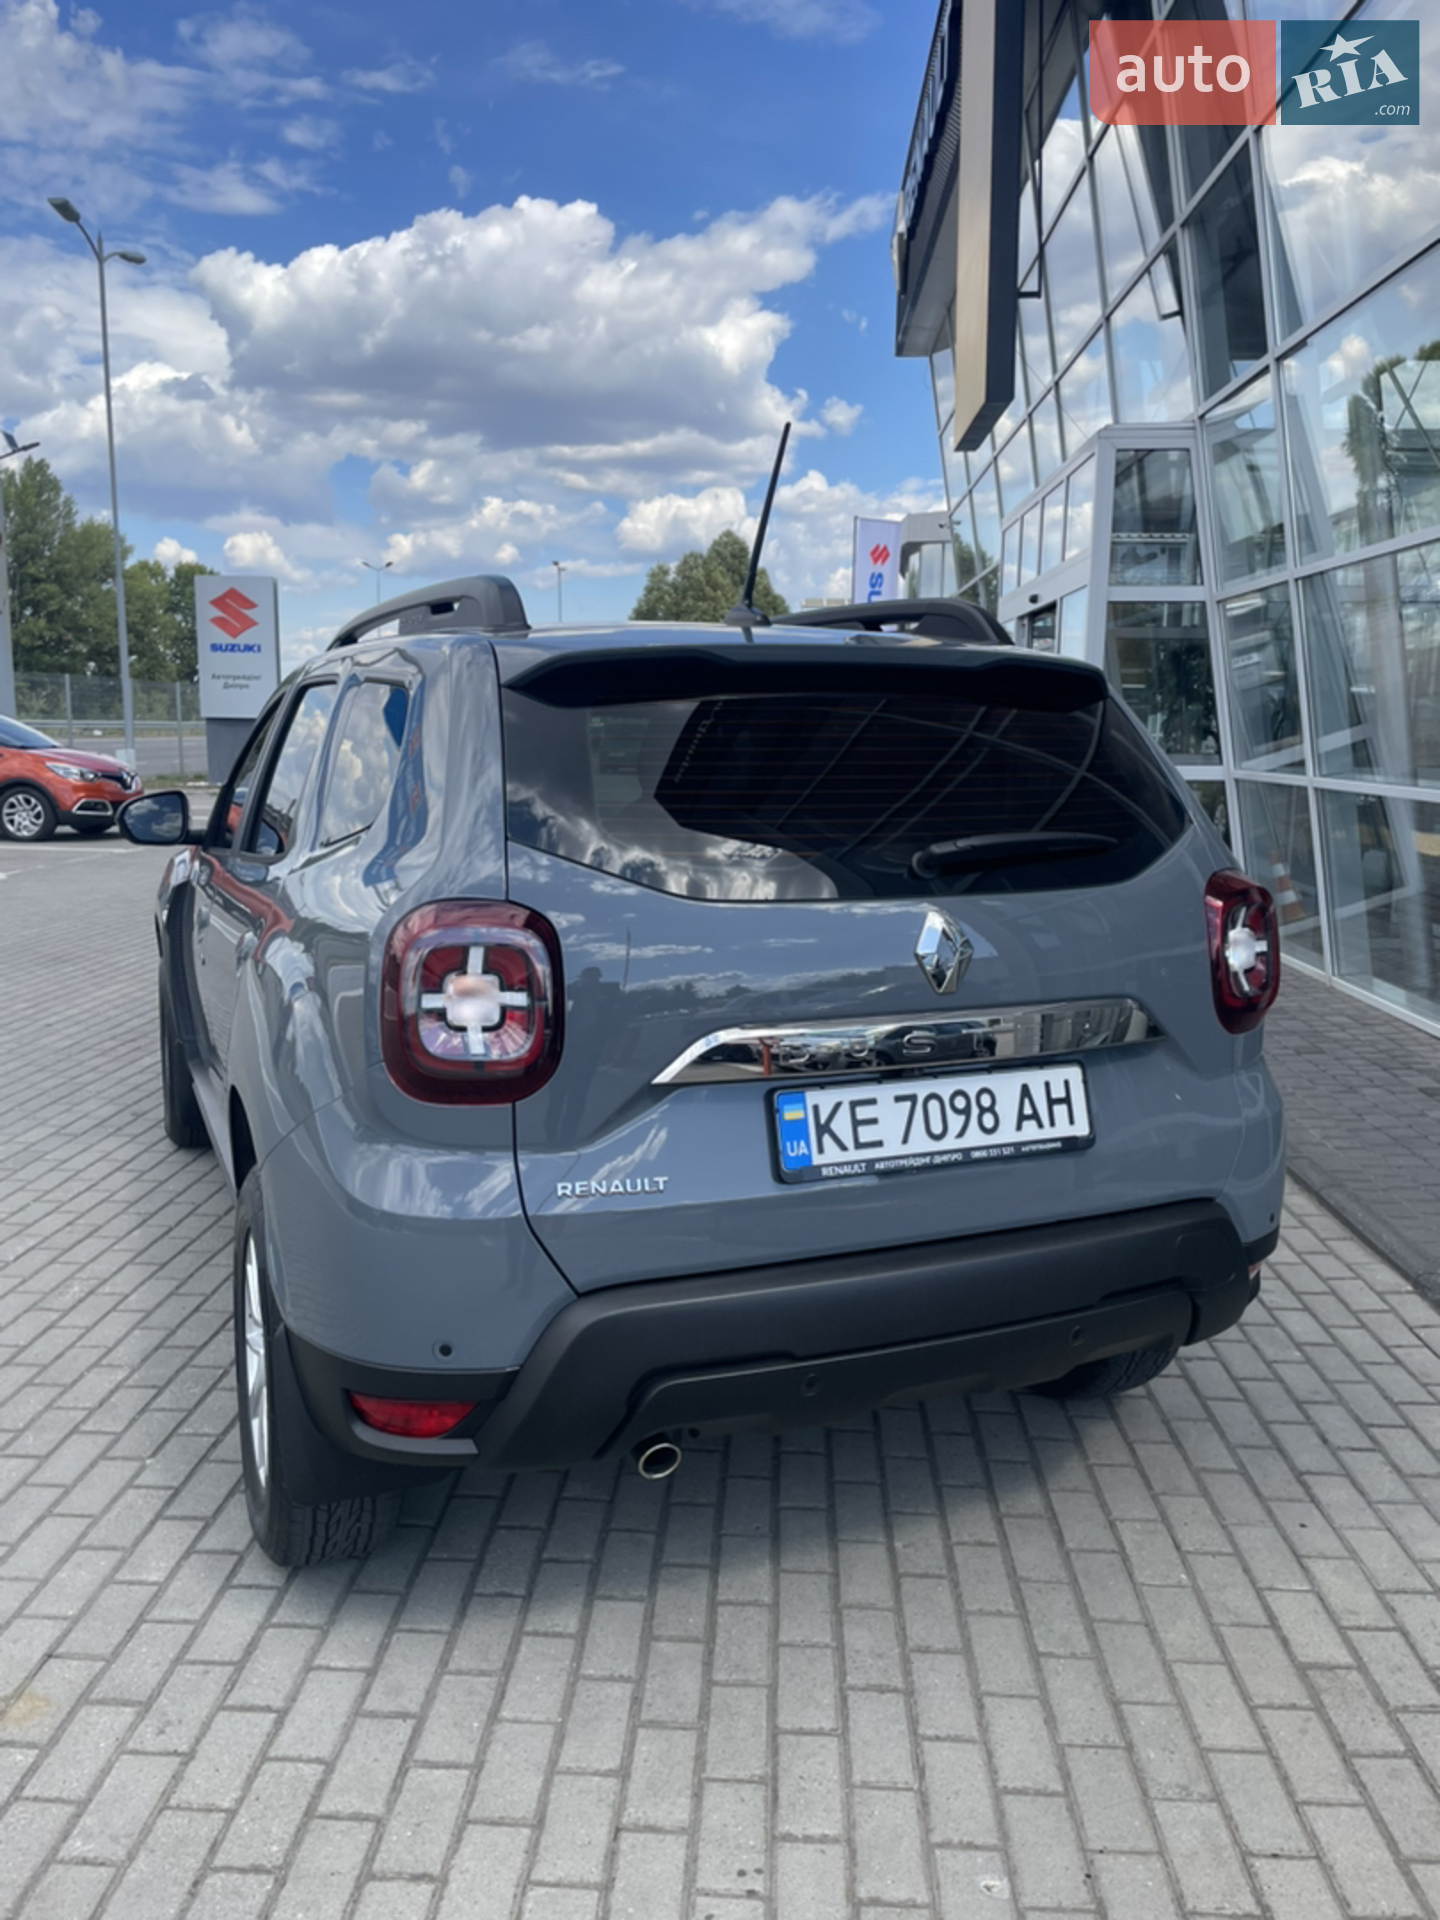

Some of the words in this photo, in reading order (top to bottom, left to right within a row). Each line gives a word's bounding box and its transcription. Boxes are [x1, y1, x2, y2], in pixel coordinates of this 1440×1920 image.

[210, 643, 262, 654] SUZUKI
[812, 1097, 884, 1155] KE
[893, 1086, 1000, 1146] 7098
[1015, 1079, 1075, 1132] AH
[786, 1139, 809, 1157] UA
[821, 1162, 868, 1176] RENAULT
[556, 1176, 669, 1198] RENAULT
